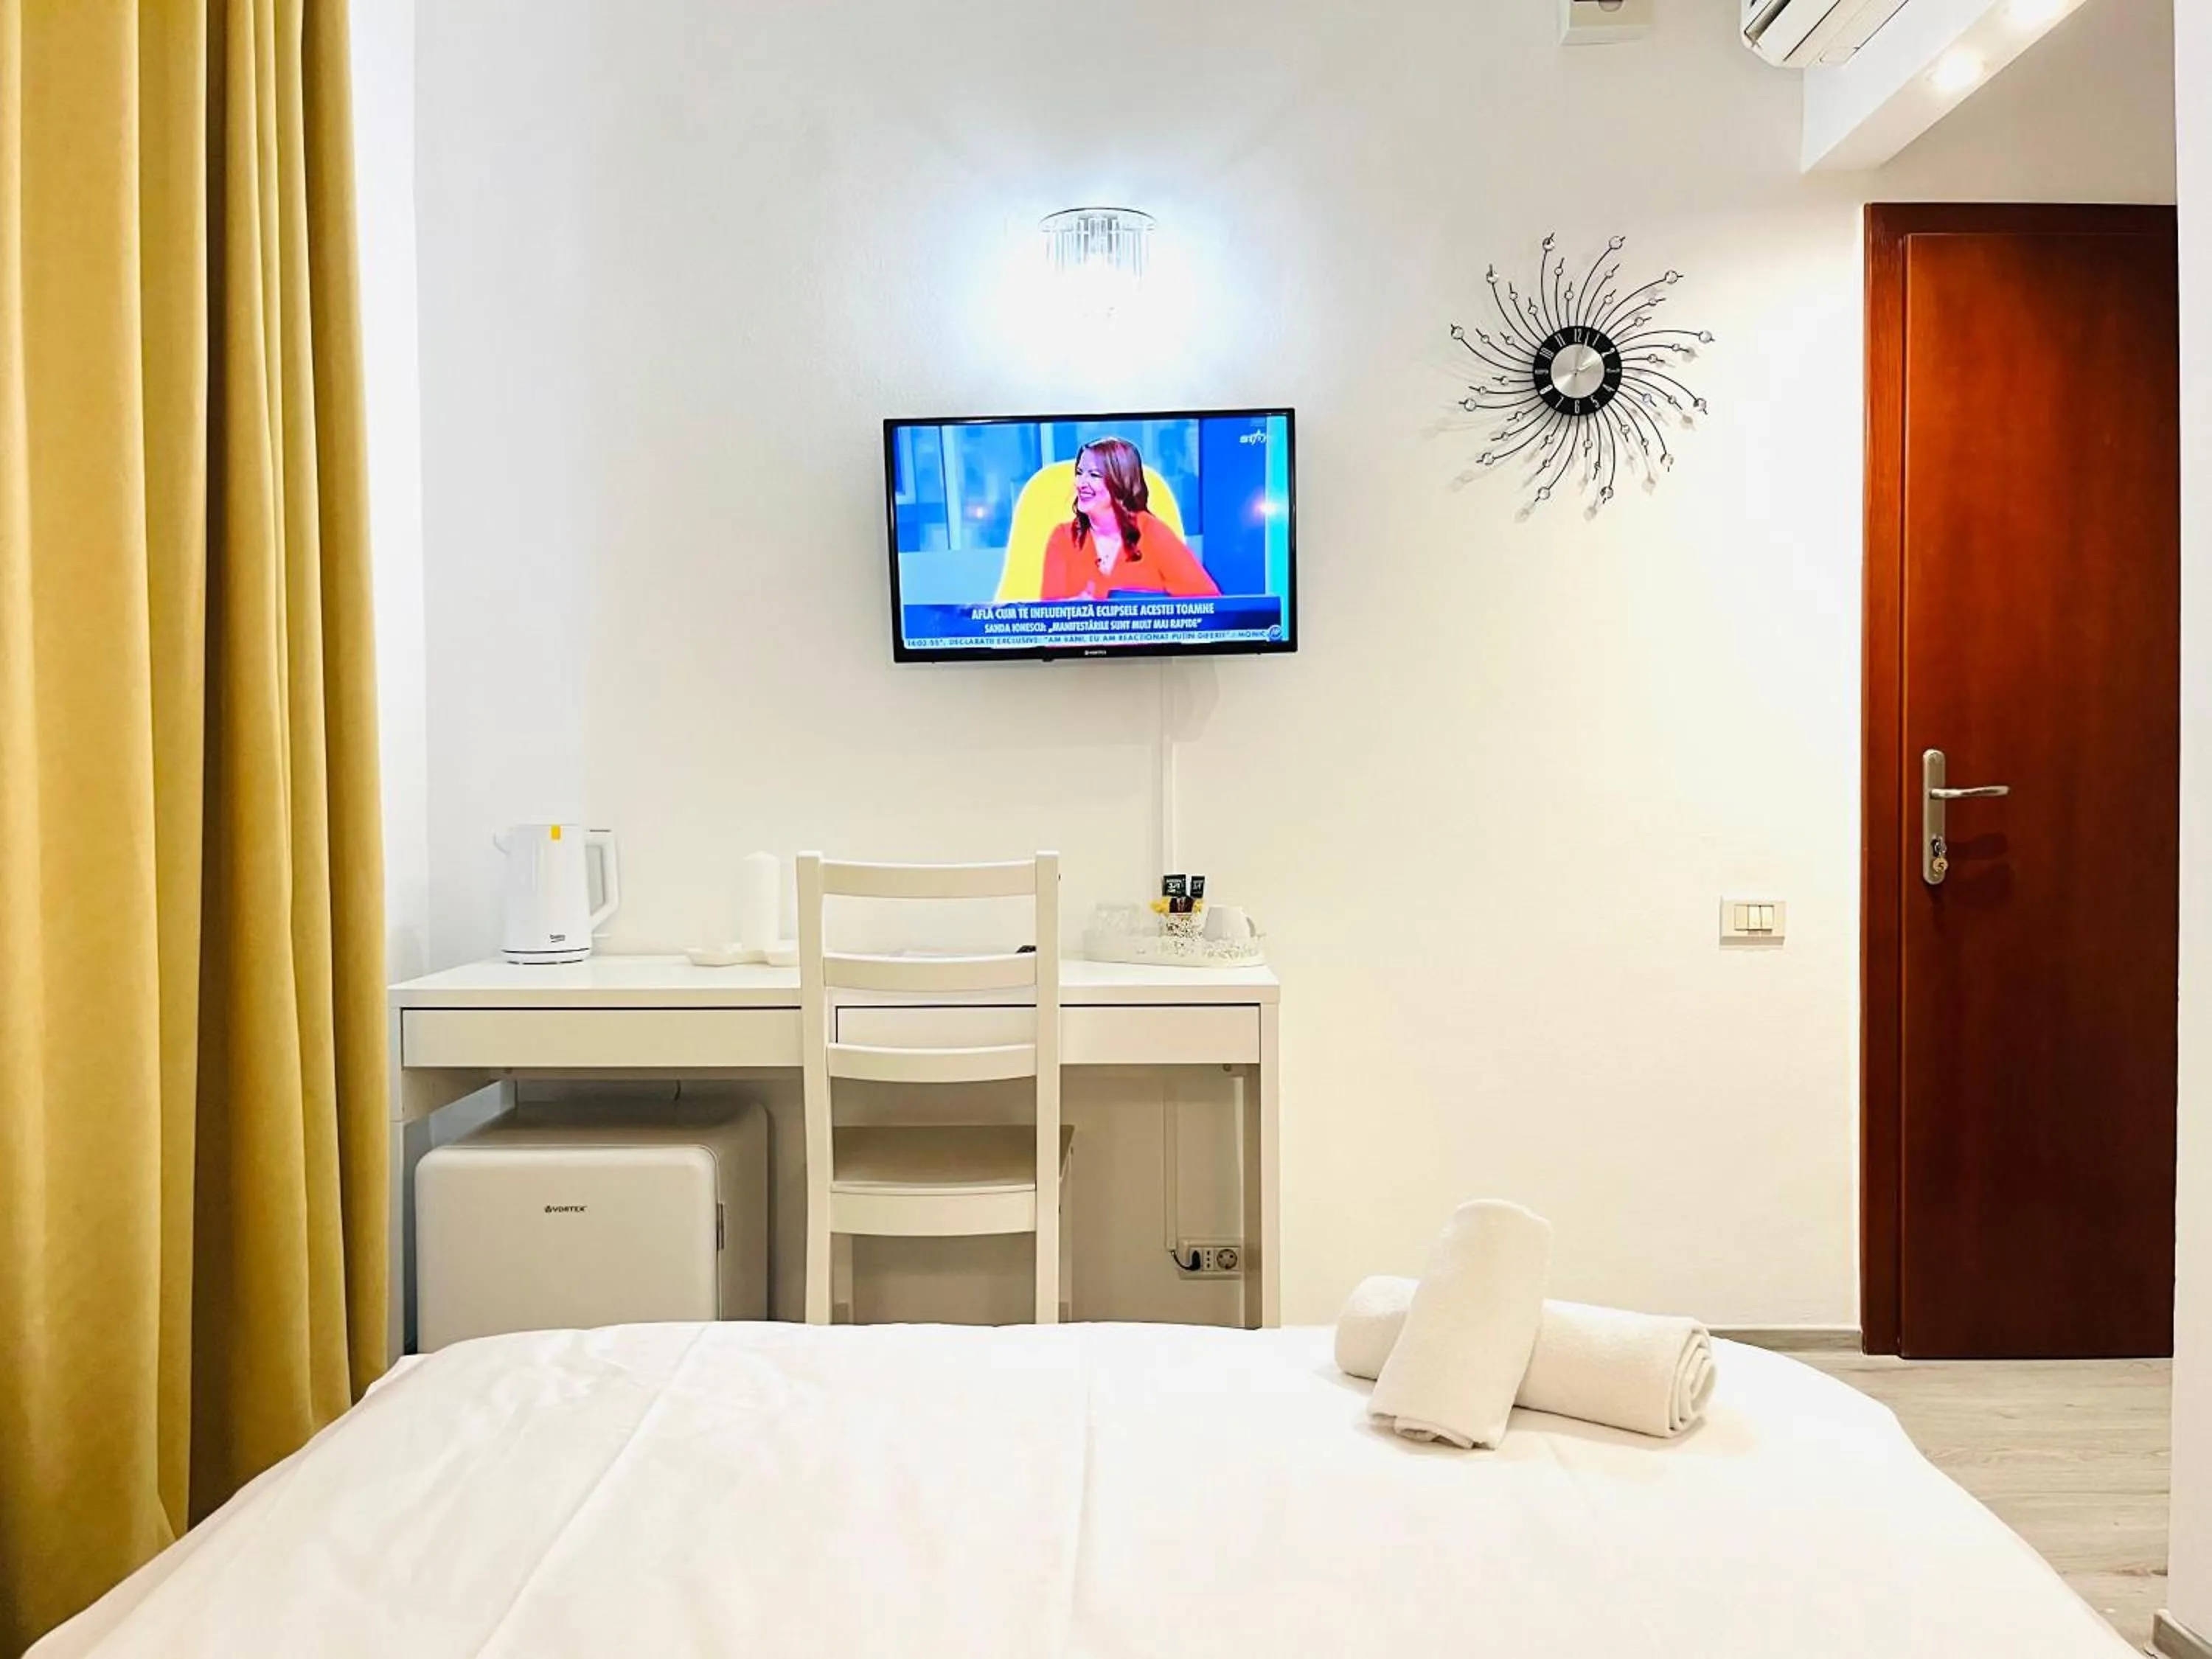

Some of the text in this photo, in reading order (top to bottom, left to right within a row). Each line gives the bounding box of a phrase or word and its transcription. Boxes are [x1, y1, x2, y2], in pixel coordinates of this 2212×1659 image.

[1554, 333, 1566, 347] 11
[1574, 328, 1582, 343] 12
[1593, 333, 1600, 347] 1
[1555, 395, 1564, 408] 7
[1574, 400, 1580, 414] 6
[1590, 395, 1601, 408] 5
[995, 608, 1017, 619] CUM
[1018, 608, 1029, 619] TE
[1096, 604, 1138, 617] ECLIPSELE
[1140, 604, 1175, 616] ACESTEI
[1176, 602, 1214, 615] TOAMNE
[985, 623, 1011, 633] SANDA
[1110, 619, 1130, 630] SUNT
[1132, 619, 1152, 630] MULT
[1153, 619, 1169, 629] MAI
[1937, 862, 1944, 871] 5
